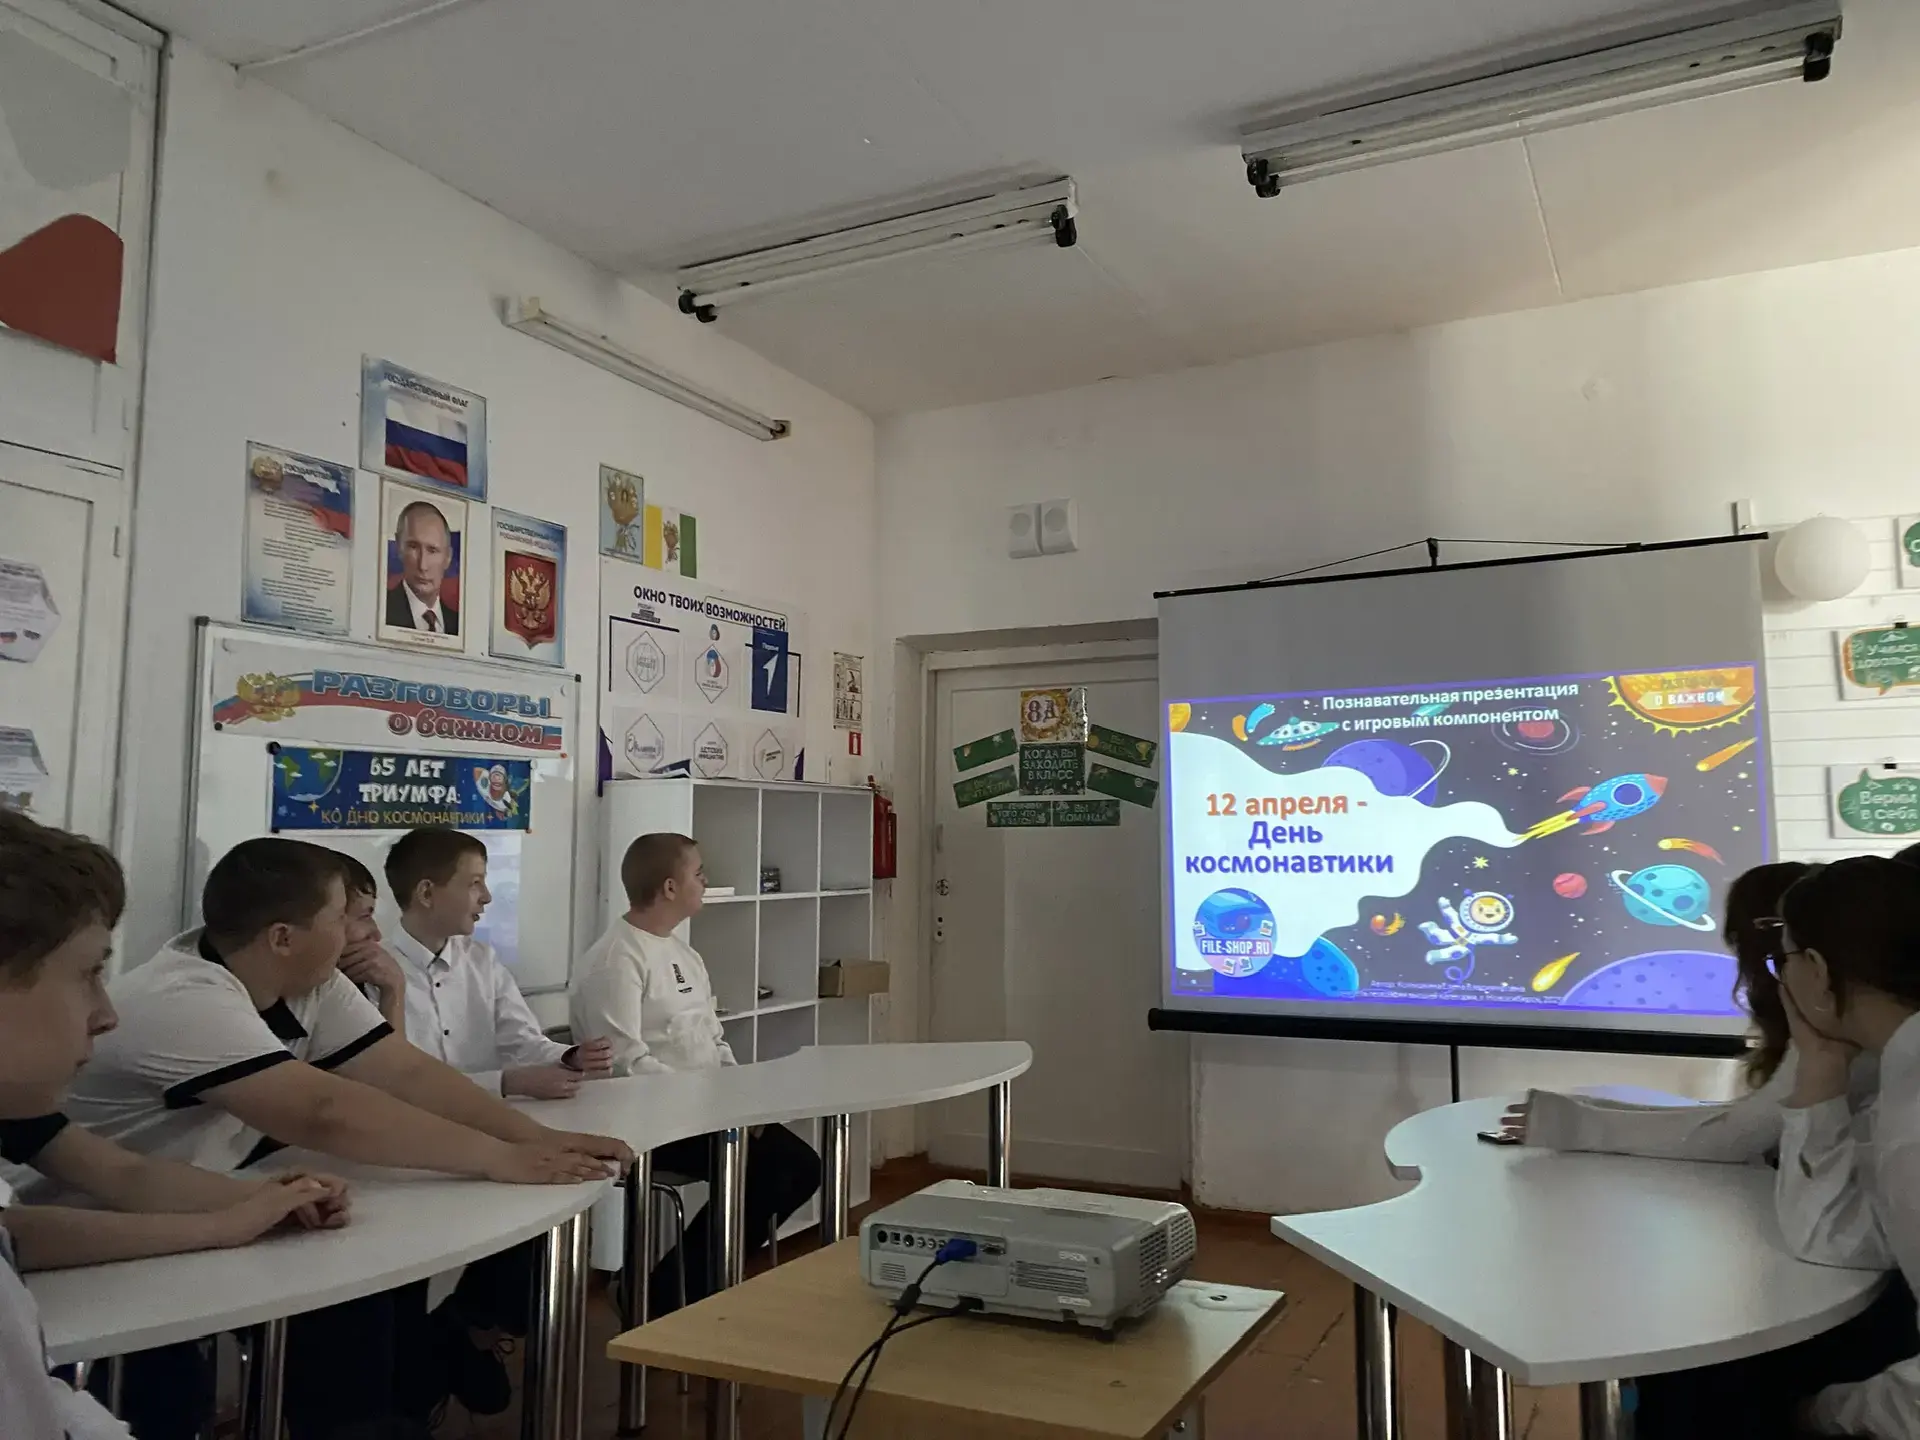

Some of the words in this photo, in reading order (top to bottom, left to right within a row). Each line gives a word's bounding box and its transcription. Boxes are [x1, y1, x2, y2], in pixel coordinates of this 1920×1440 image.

[634, 586, 666, 604] ОКНО
[669, 594, 704, 613] ТВОИХ
[706, 602, 786, 631] ВОЗМОЖНОСТЕЙ
[313, 669, 550, 719] РАЗГОВОРЫ
[1322, 690, 1460, 711] Познавательная
[1463, 684, 1579, 705] презентация
[1667, 690, 1725, 705] ВАЖНОМ
[415, 709, 543, 744] важном
[1342, 719, 1351, 732] с
[1354, 715, 1430, 734] игровым
[1433, 708, 1560, 727] компонентом
[1024, 749, 1059, 759] КОГДА
[1061, 748, 1077, 758] ВЫ
[370, 757, 396, 776] 65
[405, 759, 446, 778] ЛЕТ
[1023, 759, 1079, 770] ЗАХОДИТЕ
[1036, 770, 1074, 780] КЛАСС
[359, 783, 459, 804] ТРИУМФА
[1206, 792, 1237, 817] 12
[1245, 794, 1348, 821] апреля
[321, 811, 343, 824] КО
[383, 811, 485, 825] КОСМОНАВТИКИ
[1248, 820, 1324, 850] День
[1185, 853, 1394, 874] космонавтики
